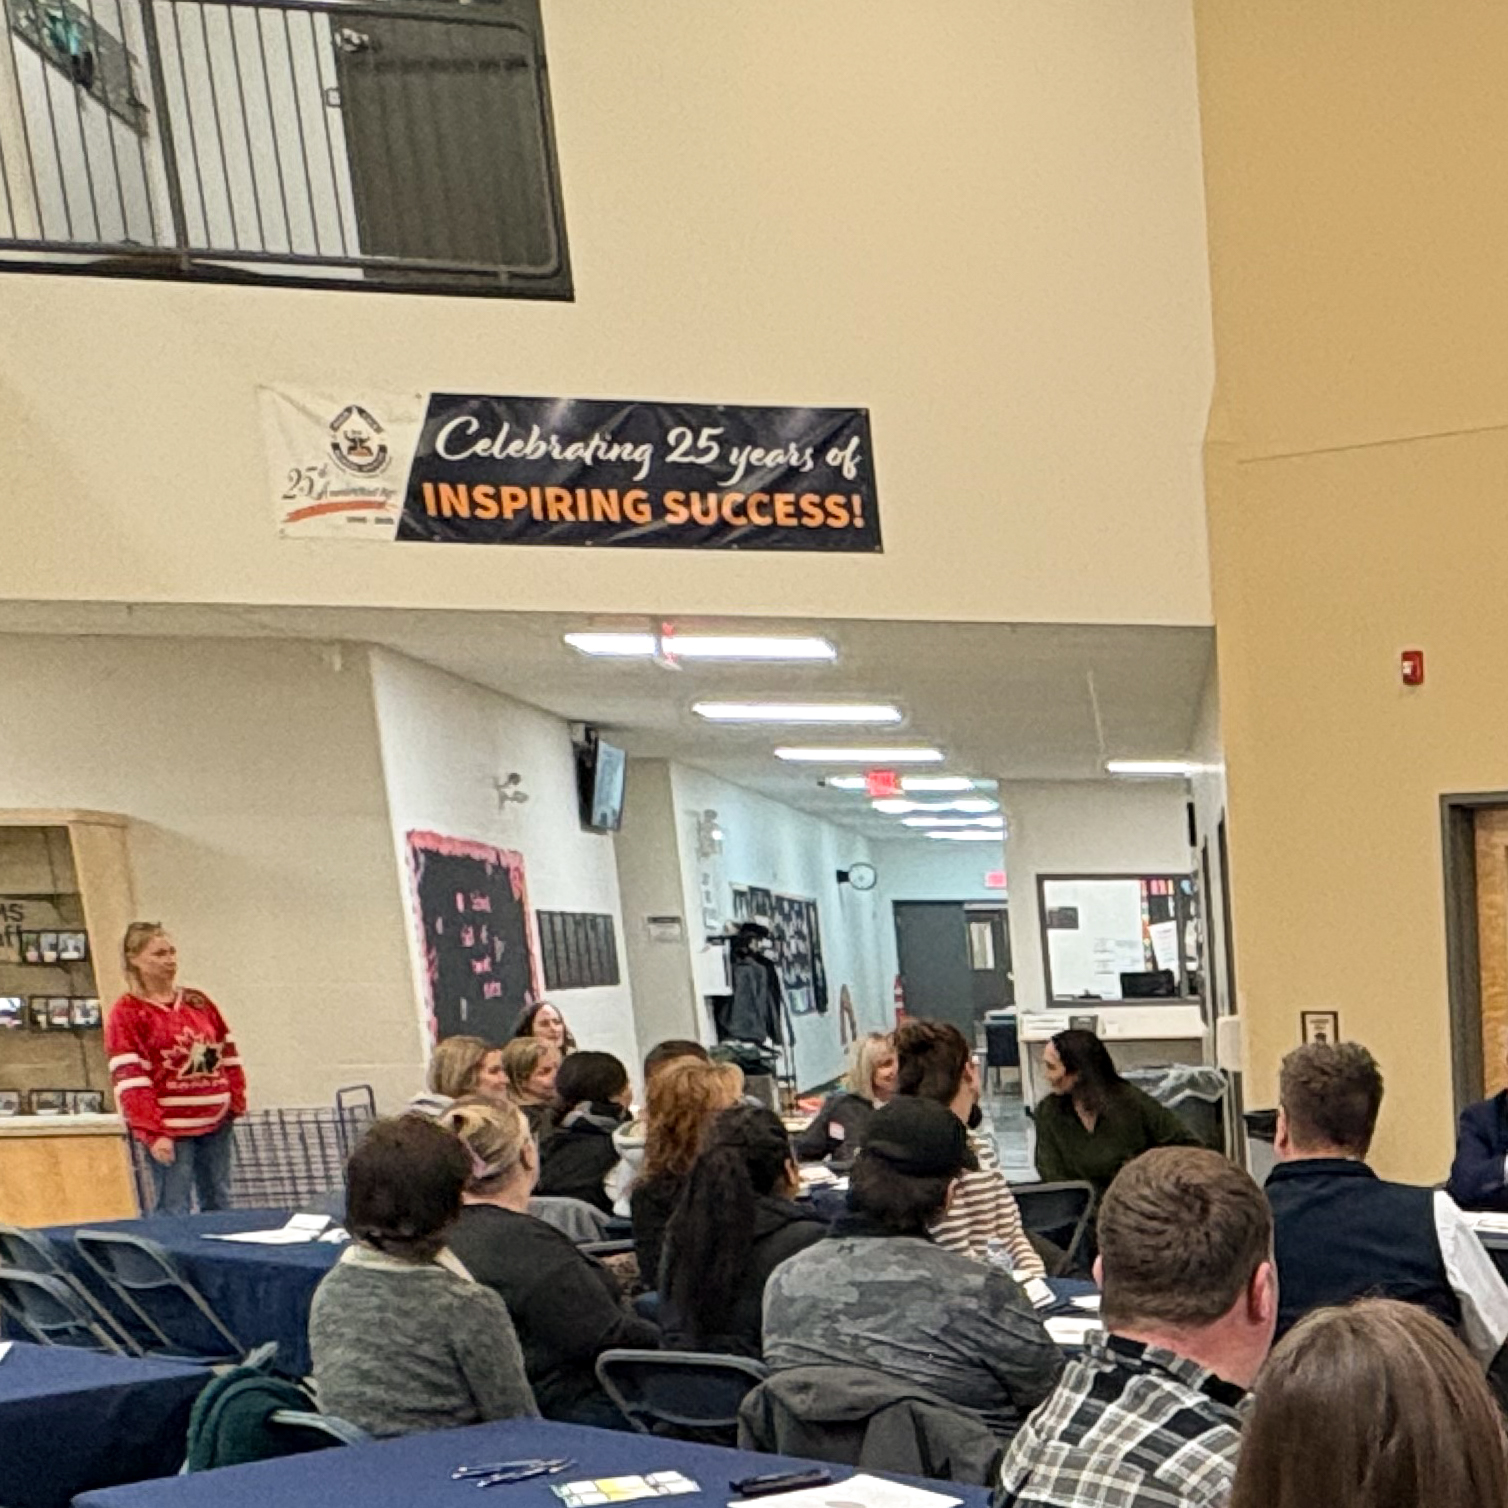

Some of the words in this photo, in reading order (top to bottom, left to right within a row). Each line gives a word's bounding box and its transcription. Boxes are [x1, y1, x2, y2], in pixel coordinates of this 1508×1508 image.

[435, 416, 653, 481] Celebrating
[665, 427, 724, 464] 25
[717, 444, 814, 487] years
[825, 435, 862, 480] of
[422, 482, 652, 524] INSPIRING
[663, 490, 865, 528] SUCCESS!
